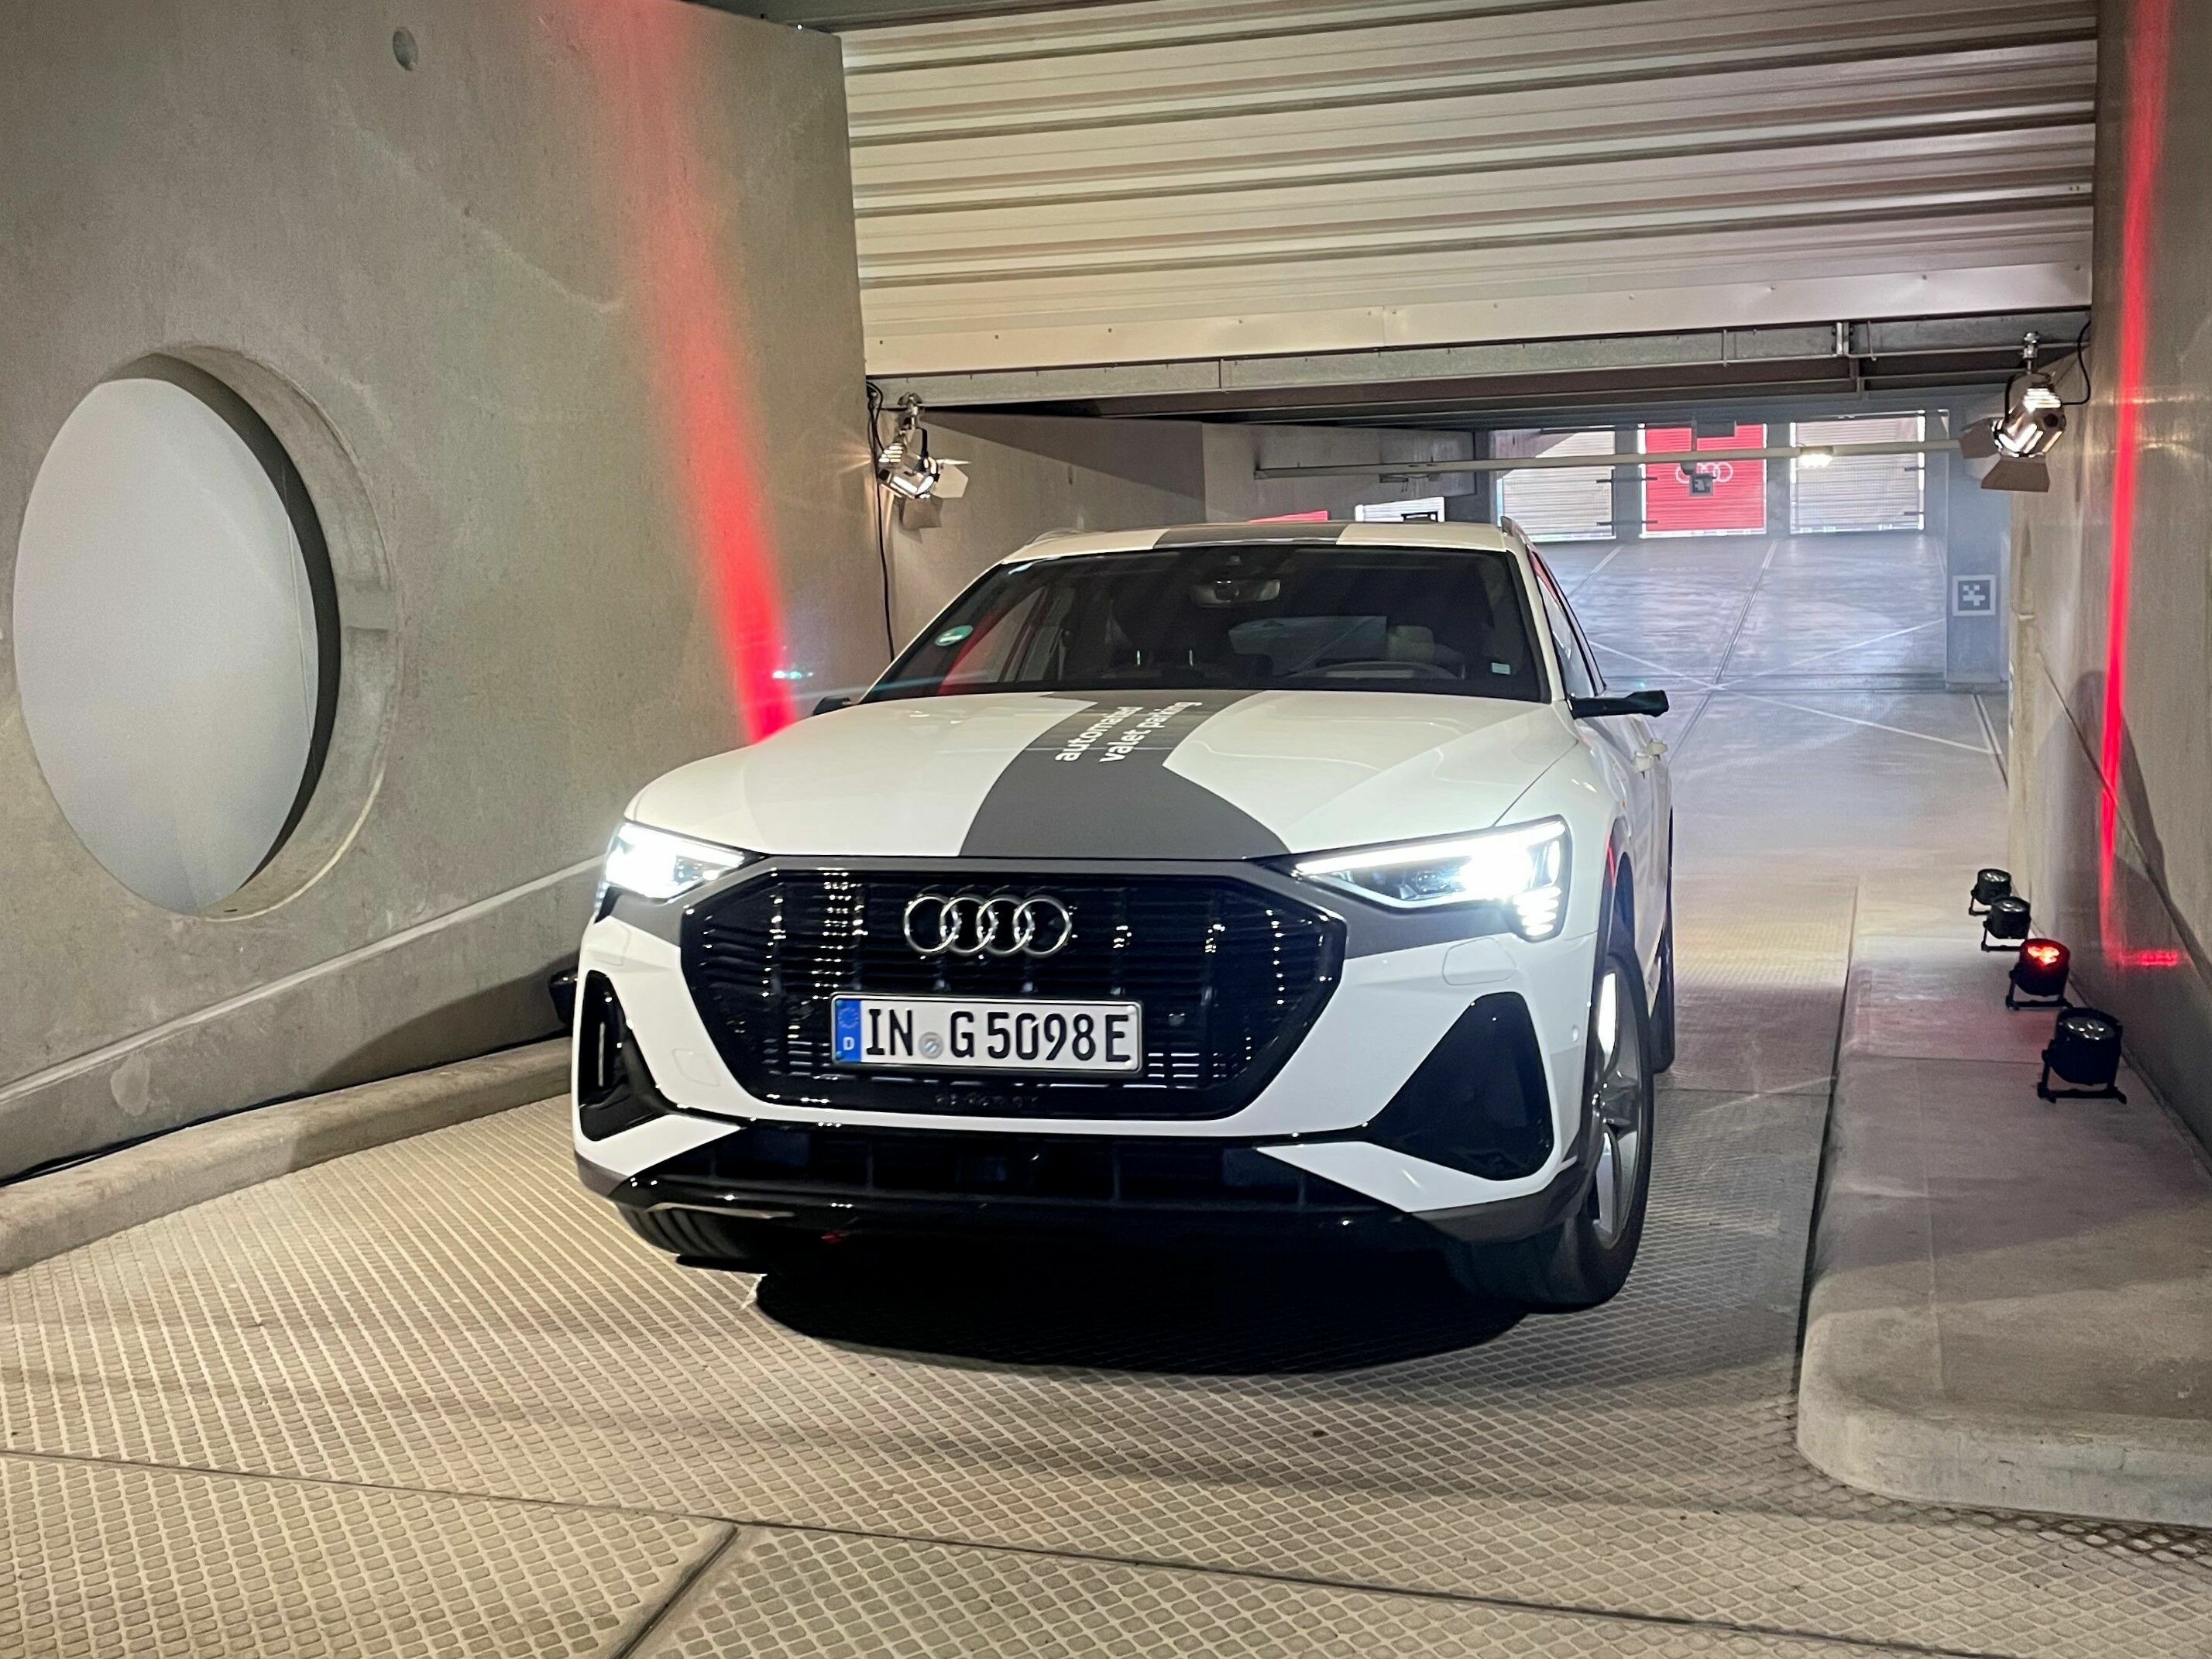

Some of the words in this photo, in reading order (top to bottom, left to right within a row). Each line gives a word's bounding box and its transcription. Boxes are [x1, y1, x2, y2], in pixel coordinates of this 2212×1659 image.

[1099, 729, 1152, 763] valet
[1136, 702, 1202, 728] parking
[843, 1036, 855, 1050] D
[866, 1008, 913, 1056] IN
